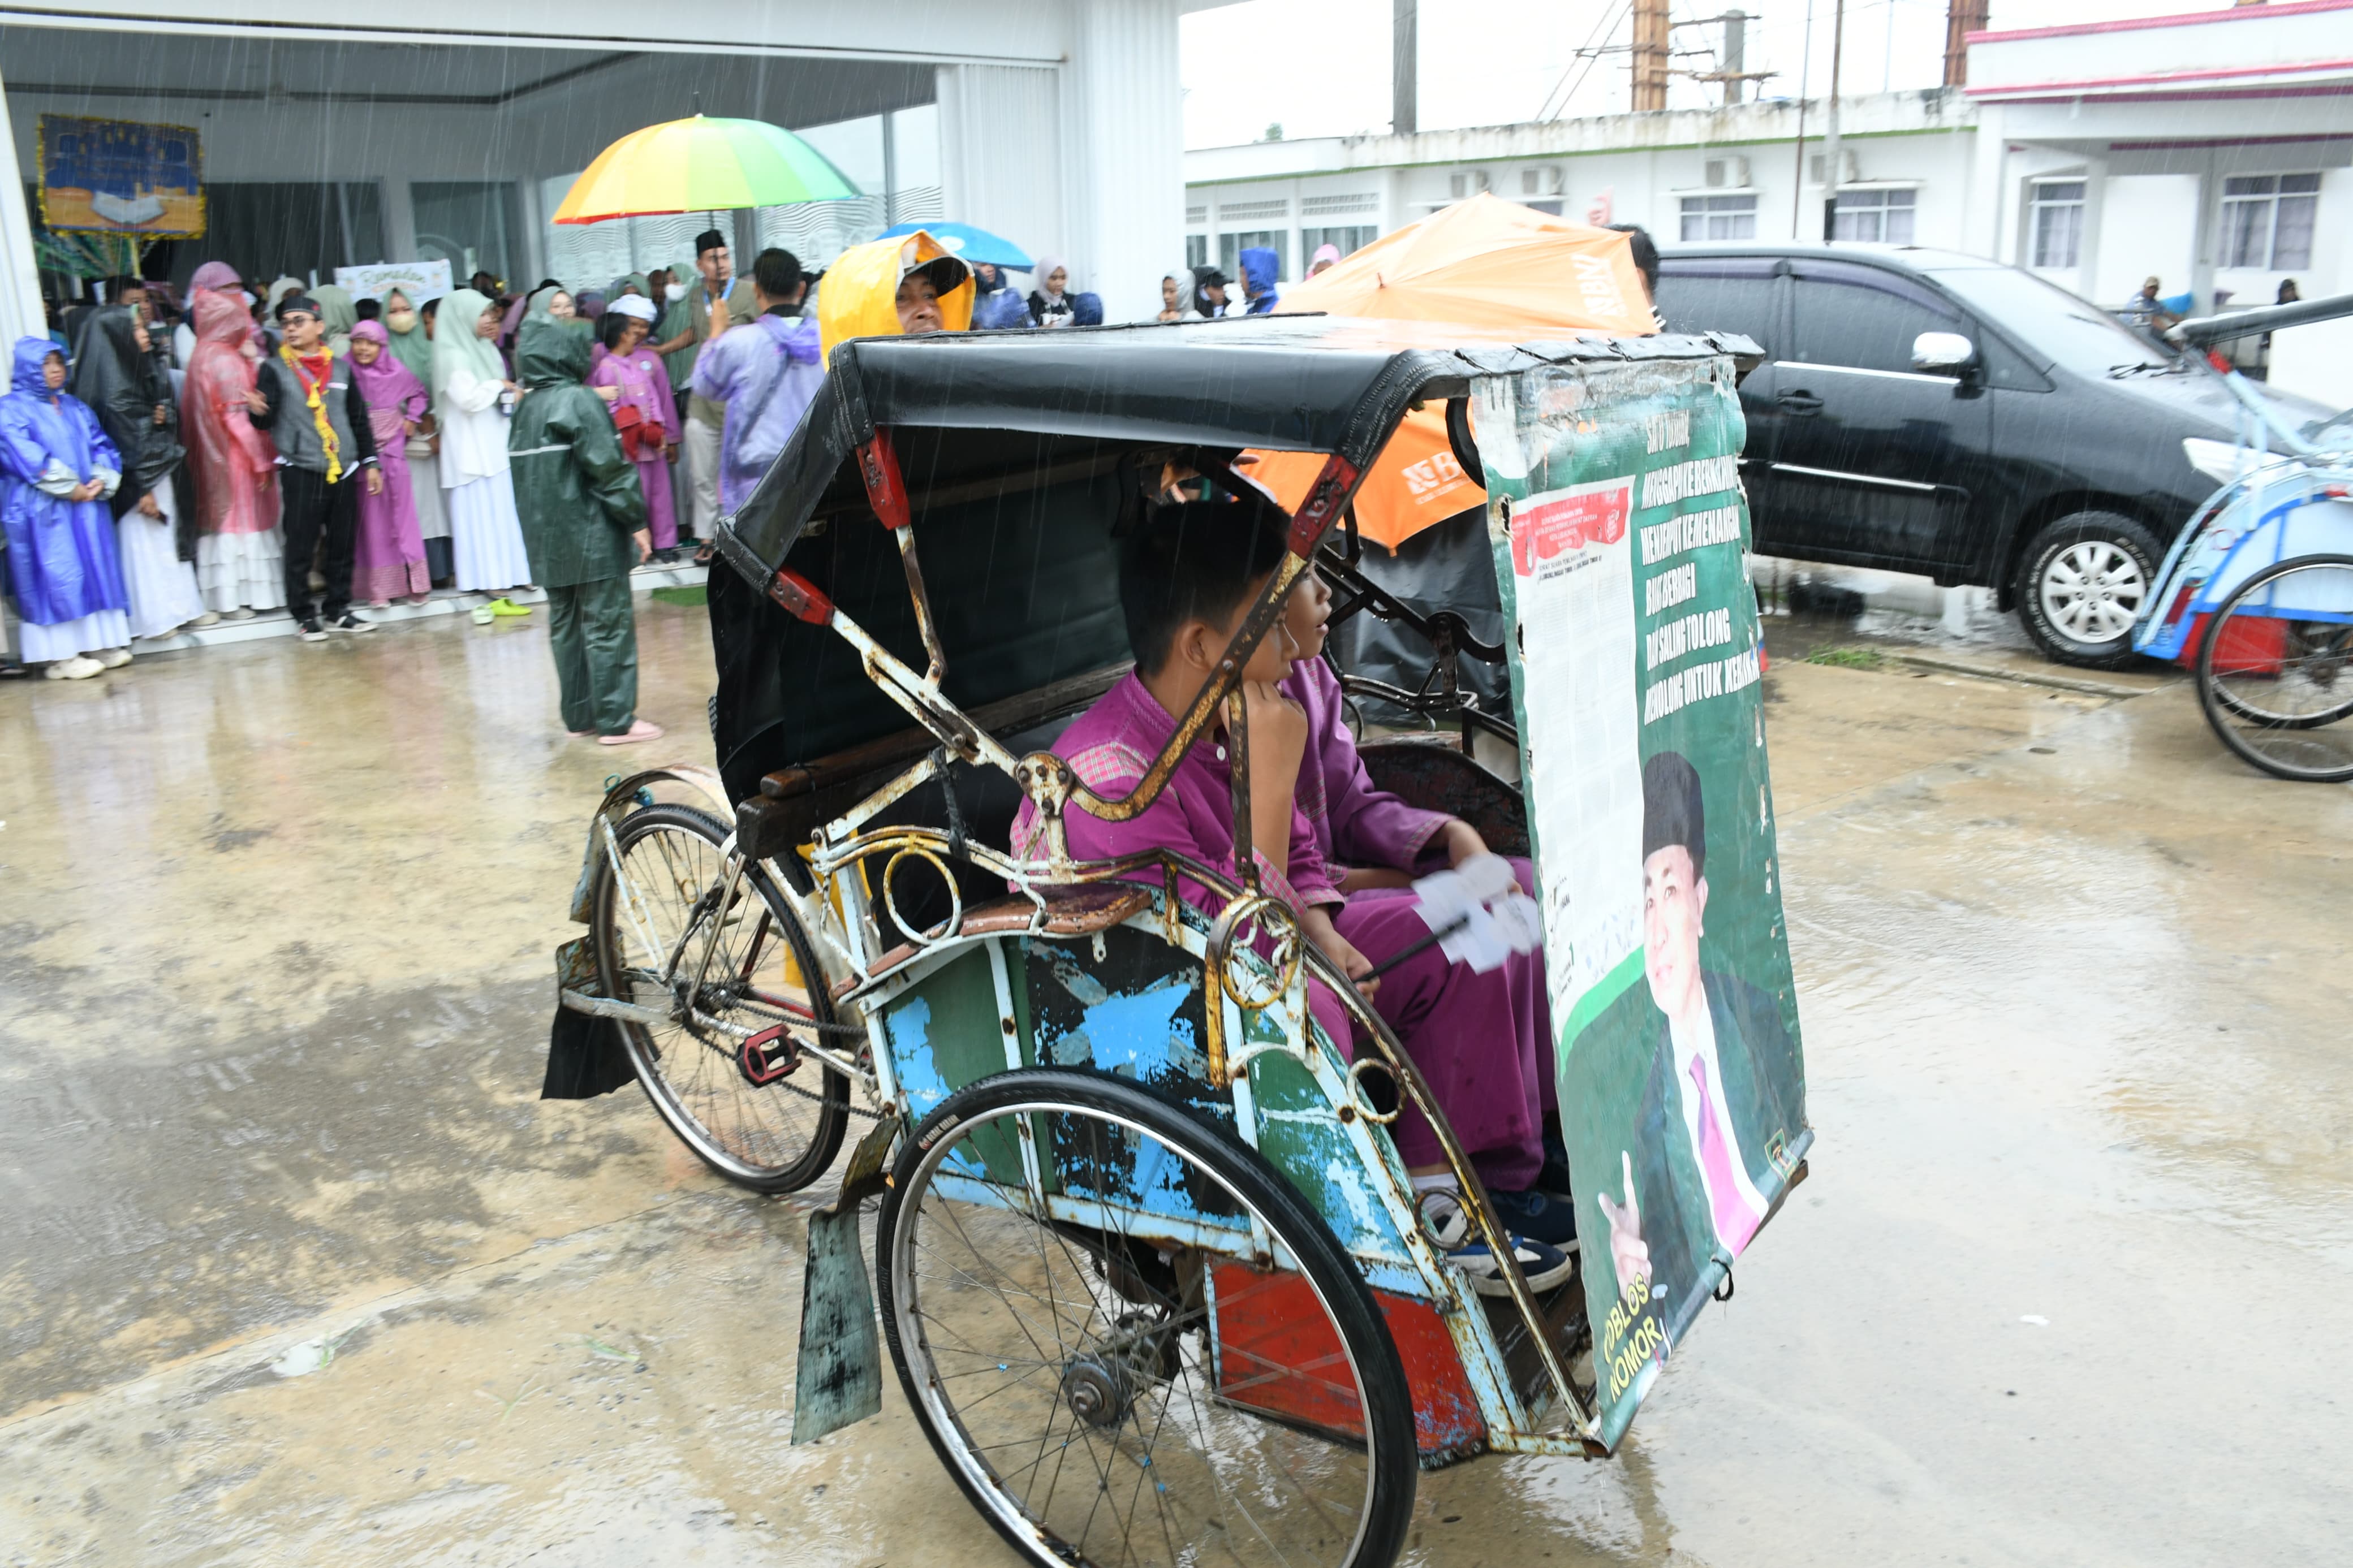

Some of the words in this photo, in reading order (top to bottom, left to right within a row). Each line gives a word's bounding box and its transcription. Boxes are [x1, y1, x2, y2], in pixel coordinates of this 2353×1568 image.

[1640, 516, 1682, 567] MENJEMPUT
[1682, 504, 1741, 553] KEMENANGAN
[1662, 562, 1696, 609] BERBAGI
[1645, 628, 1658, 672] DAN
[1659, 617, 1686, 664] SALING
[1686, 607, 1731, 651] TOLONG
[1644, 672, 1683, 727] MENOLONG
[1683, 660, 1723, 706] UNTUK
[1609, 1315, 1663, 1404] NOMOR
